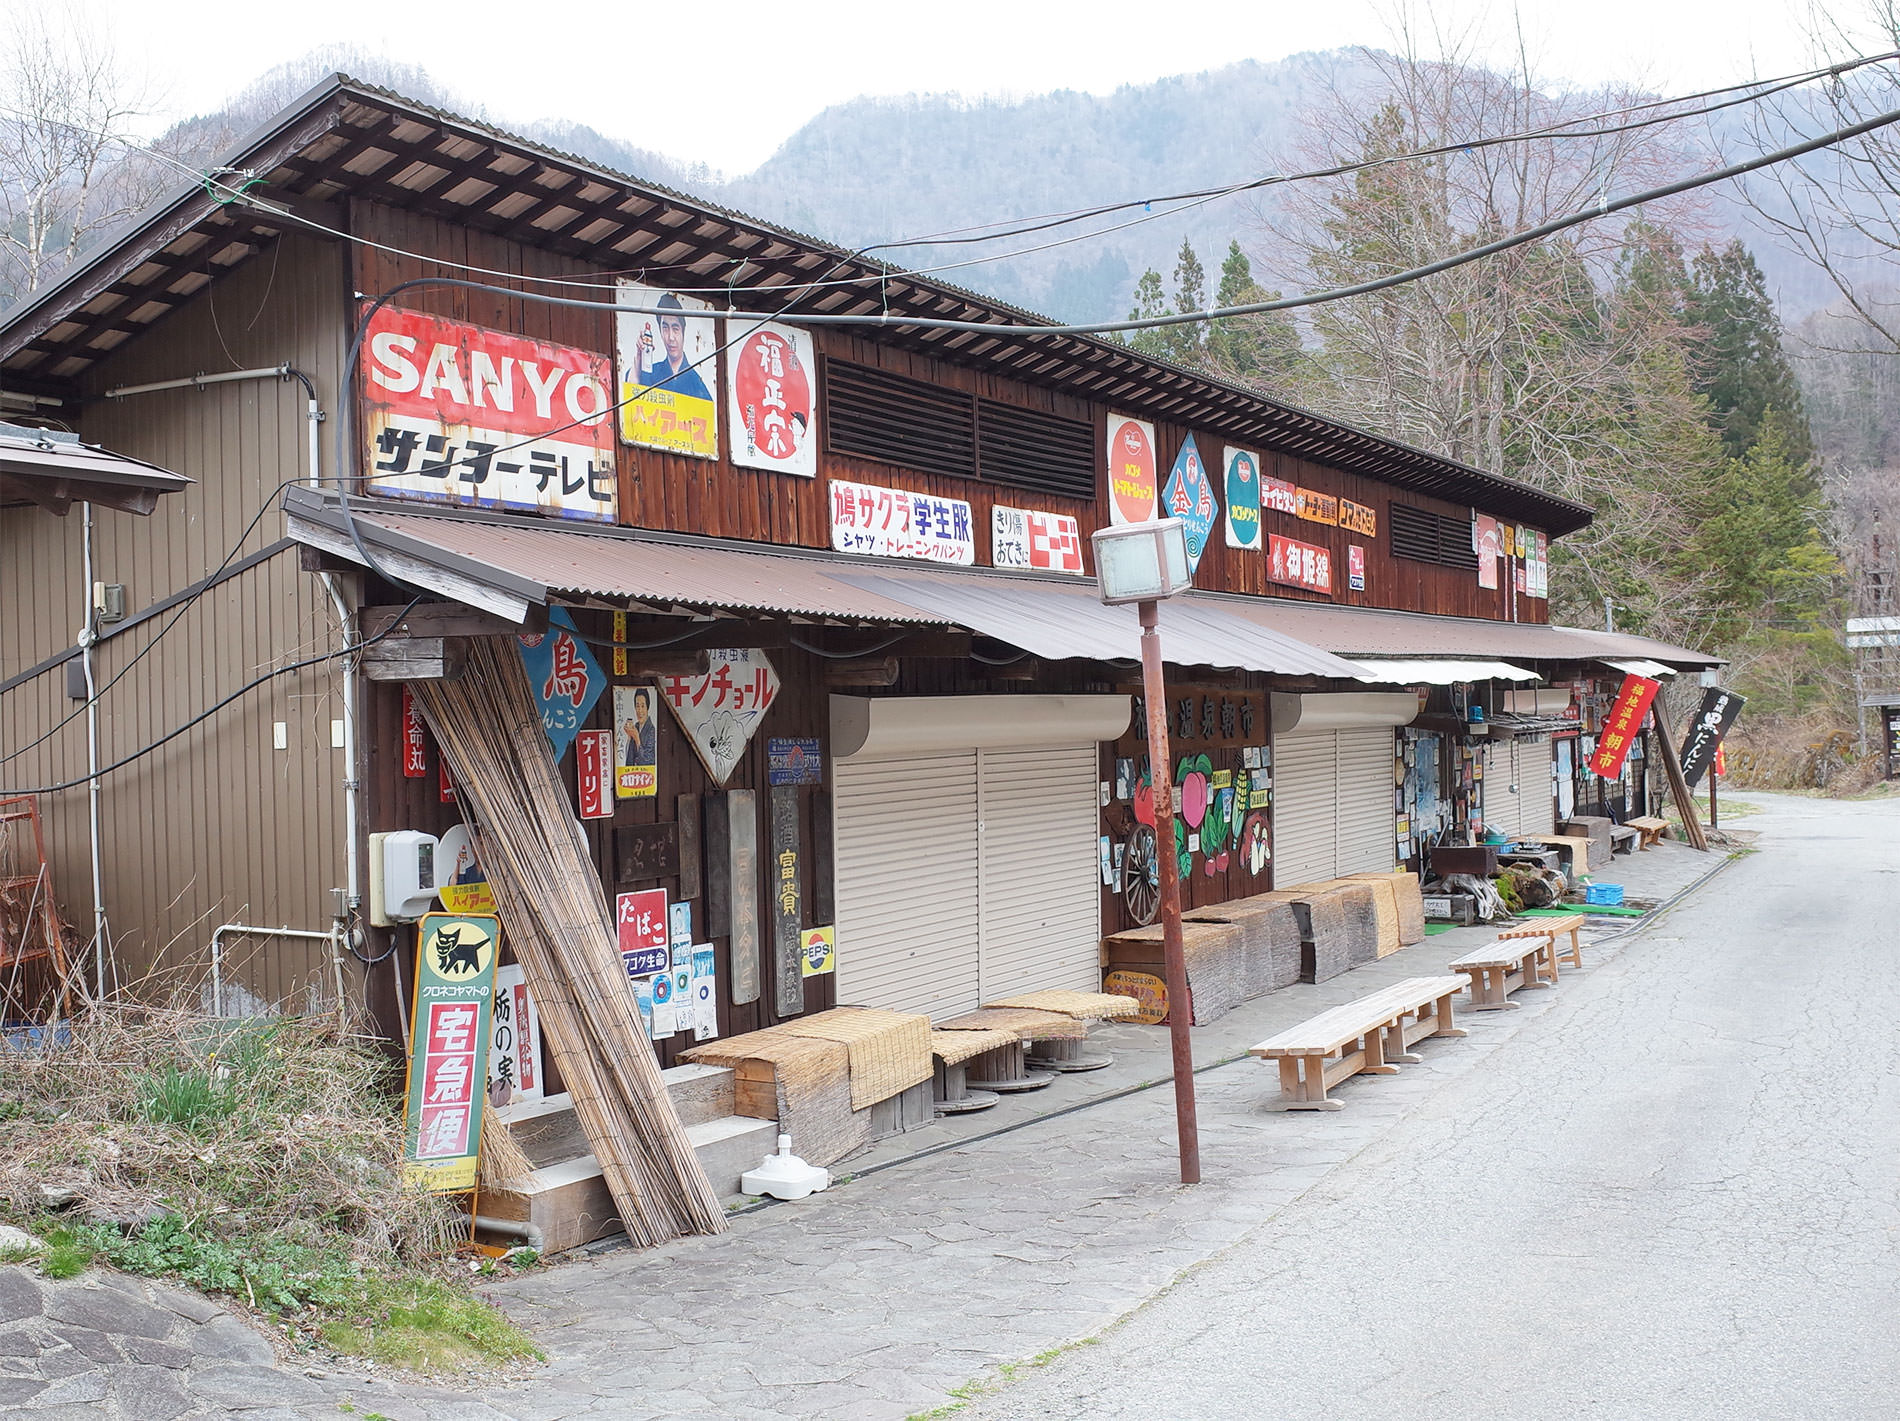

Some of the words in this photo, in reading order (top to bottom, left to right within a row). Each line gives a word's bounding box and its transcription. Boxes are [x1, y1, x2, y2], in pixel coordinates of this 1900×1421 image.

[370, 331, 607, 426] SANYO
[756, 334, 787, 456] 福正宗
[632, 405, 707, 444] ハイアース
[375, 427, 613, 502] サンヨーテレビ
[1114, 478, 1154, 500] トマトジュース
[834, 485, 970, 542] 鳩サクラ学生服
[997, 510, 1023, 536] きり傷
[1170, 467, 1213, 523] 金鳥
[1231, 505, 1259, 523] カゴメソース
[543, 632, 589, 708] 鳥
[665, 663, 774, 710] キンチョール
[1135, 695, 1254, 741] 福温泉朝市
[582, 736, 598, 813] ナーリン
[779, 849, 799, 916] 富貴
[620, 897, 665, 944] たばこ
[801, 943, 834, 960] PEPSI
[422, 985, 490, 998] クロネコヤマトの
[493, 988, 516, 1092] 栃の実
[425, 1007, 474, 1153] 宅急便
